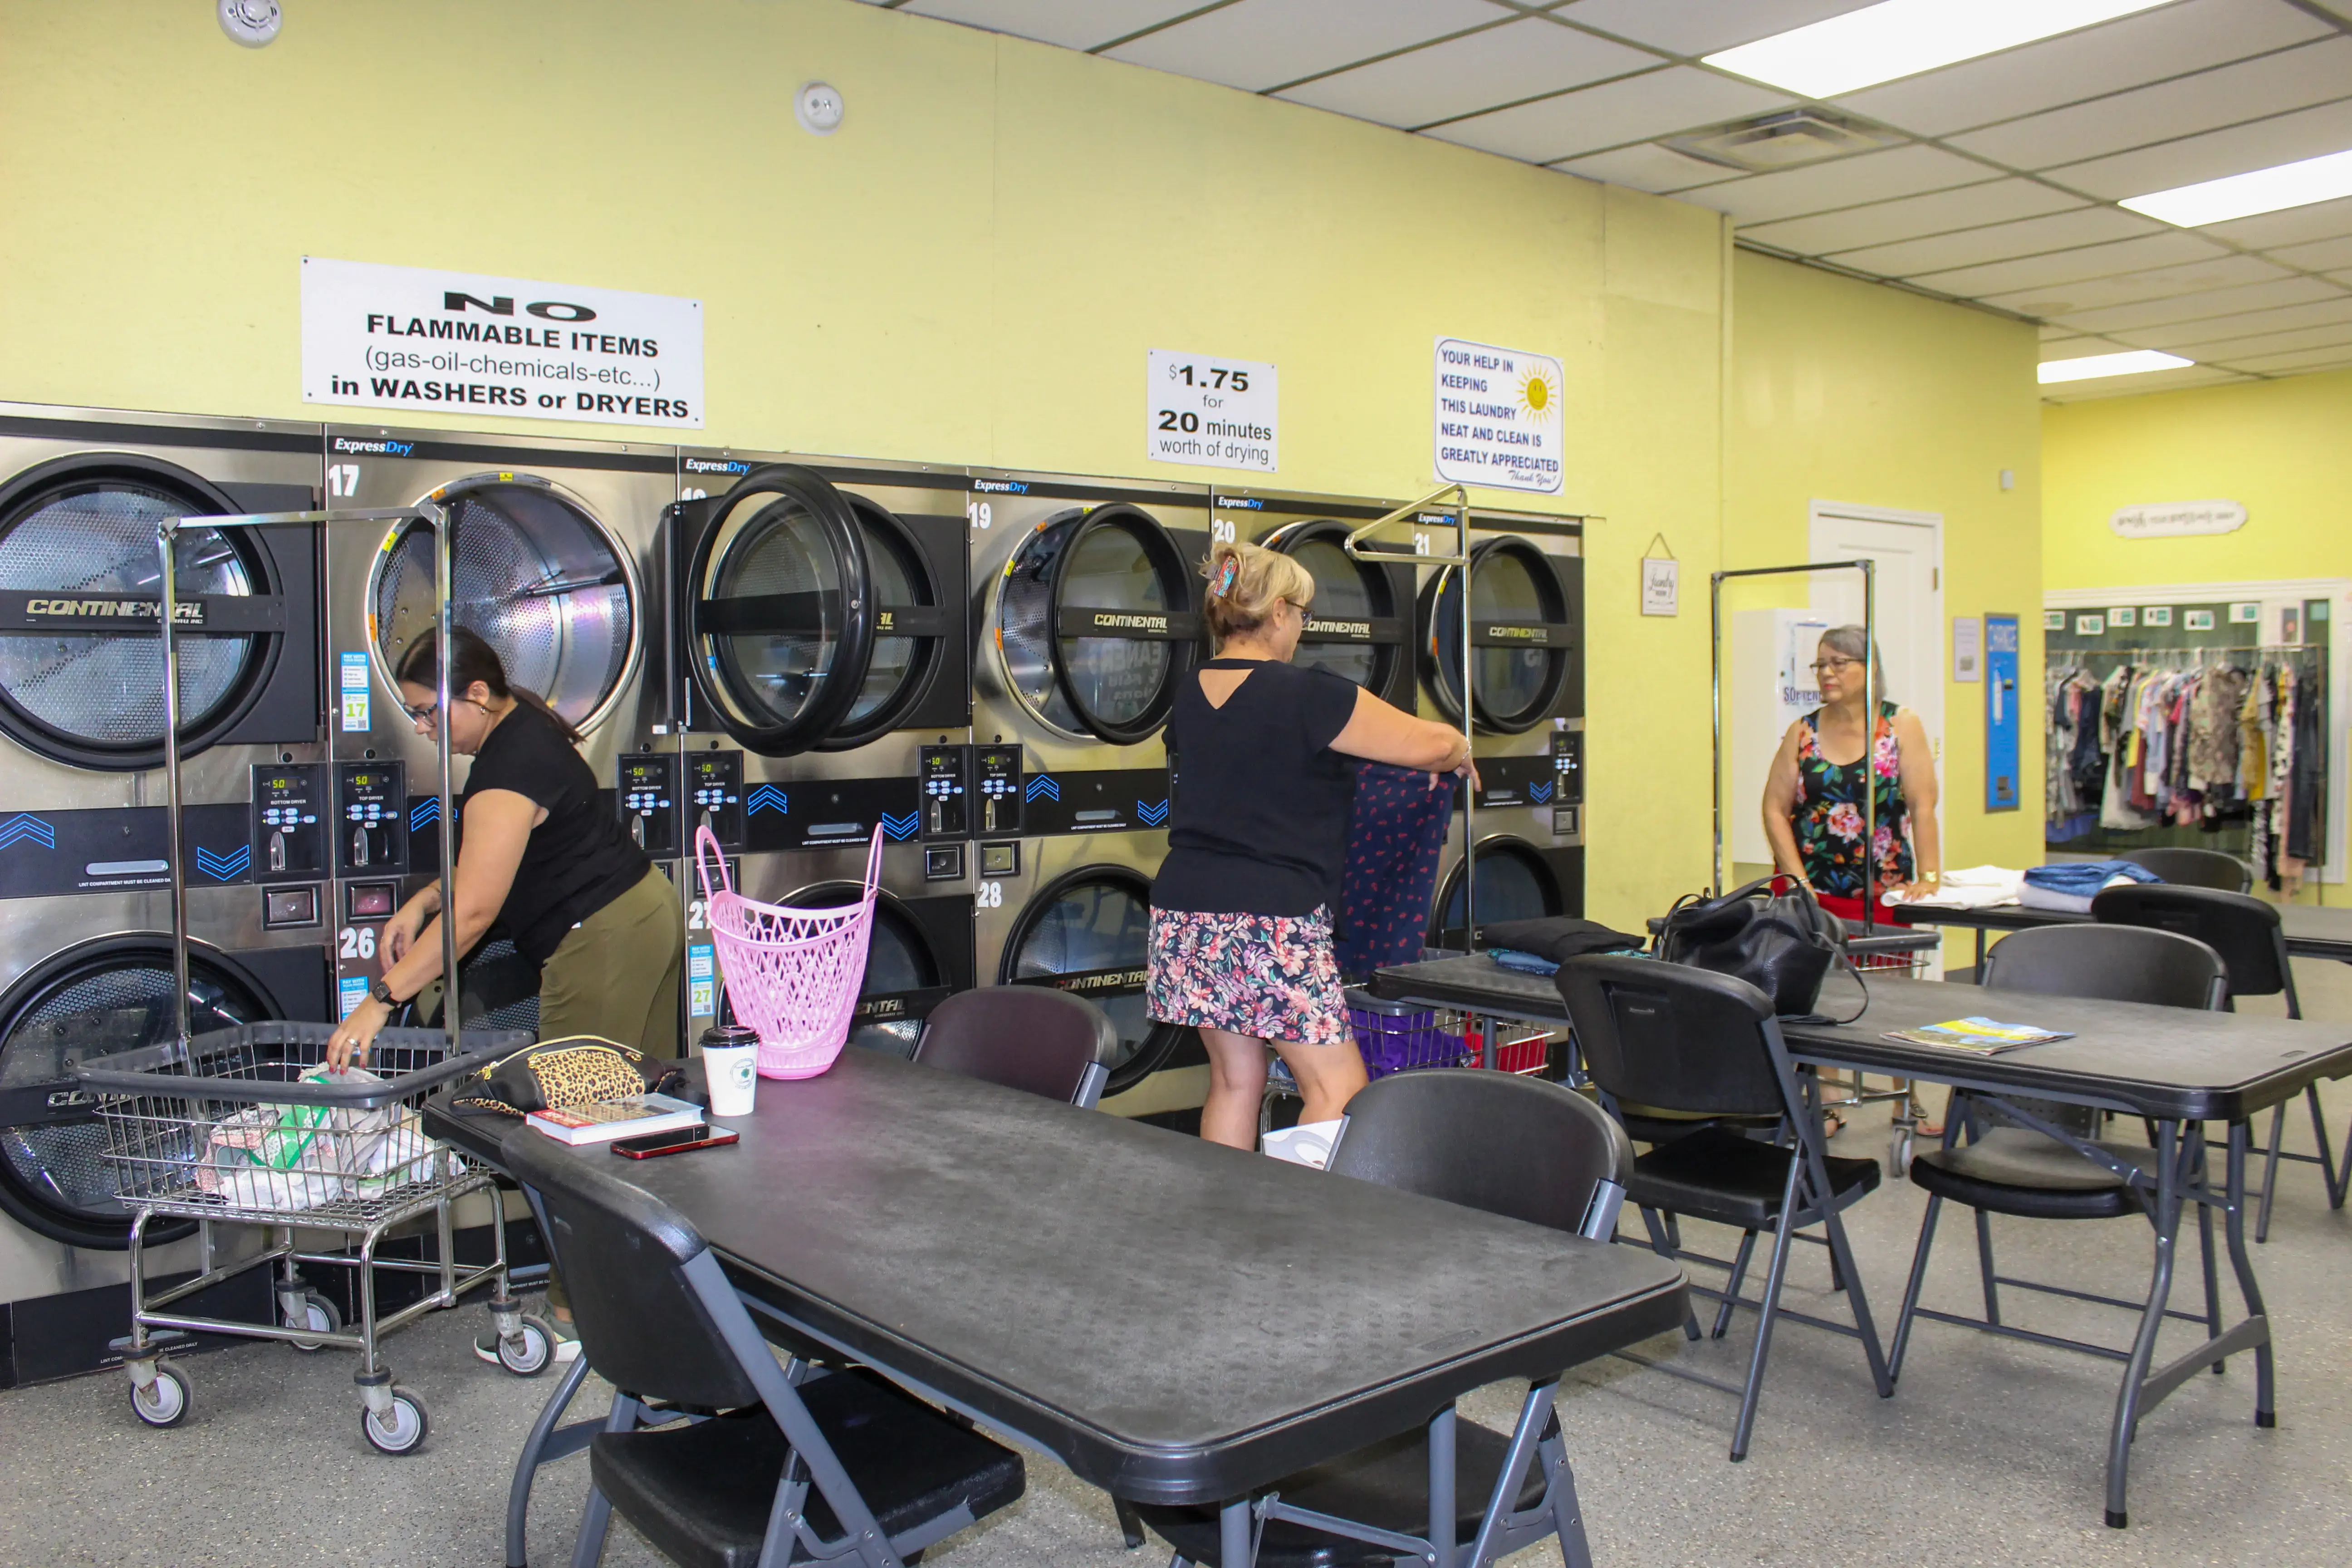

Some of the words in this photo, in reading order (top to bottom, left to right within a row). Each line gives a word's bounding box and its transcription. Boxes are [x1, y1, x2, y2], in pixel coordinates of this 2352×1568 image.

[444, 291, 597, 322] NO
[367, 314, 560, 348] FLAMMABLE
[571, 332, 658, 357] ITEMS
[365, 345, 661, 392] (gas-oil-chemicals-etc...)
[1441, 348, 1470, 366] YOUR
[1474, 355, 1499, 370] HELP
[1504, 359, 1514, 372] IN
[1169, 363, 1249, 392] $1.75
[1441, 374, 1487, 392] KEEPING
[331, 376, 359, 395] in
[371, 377, 528, 406] WASHERS
[538, 393, 567, 409] or
[577, 392, 688, 418] DRYERS
[1202, 395, 1224, 408] for
[1441, 398, 1465, 413] THIS
[1469, 402, 1517, 420] LAUNDRY
[1158, 409, 1199, 433] 20
[1207, 419, 1272, 441] minutes
[1441, 422, 1469, 438] NEAT
[1472, 427, 1493, 441] AND
[1497, 430, 1529, 445] CLEAN
[1533, 434, 1542, 447] IS
[334, 438, 413, 457] ExpressDry
[1160, 439, 1201, 455] worth
[1207, 441, 1220, 456] of
[1225, 443, 1269, 465] drying
[686, 458, 750, 475] ExpressDry
[1441, 446, 1488, 465] GREATLY
[1491, 452, 1558, 472] APPRECIATED
[328, 464, 360, 496] 17
[1508, 470, 1534, 481] Thank
[975, 479, 1028, 495] ExpressDry
[1218, 497, 1263, 510] ExpressDry
[969, 502, 991, 529] 19
[1418, 513, 1455, 525] ExpressDry
[1214, 519, 1235, 544] 20
[1415, 532, 1430, 555] 21
[26, 599, 203, 617] CONTINENAL
[1094, 614, 1167, 629] CONTINENTAL
[346, 703, 366, 717] 17
[356, 775, 368, 785] 50
[633, 767, 643, 775] 50
[273, 779, 285, 789] 50
[977, 882, 1002, 908] 28
[340, 927, 375, 959] 26
[693, 990, 710, 1003] 27
